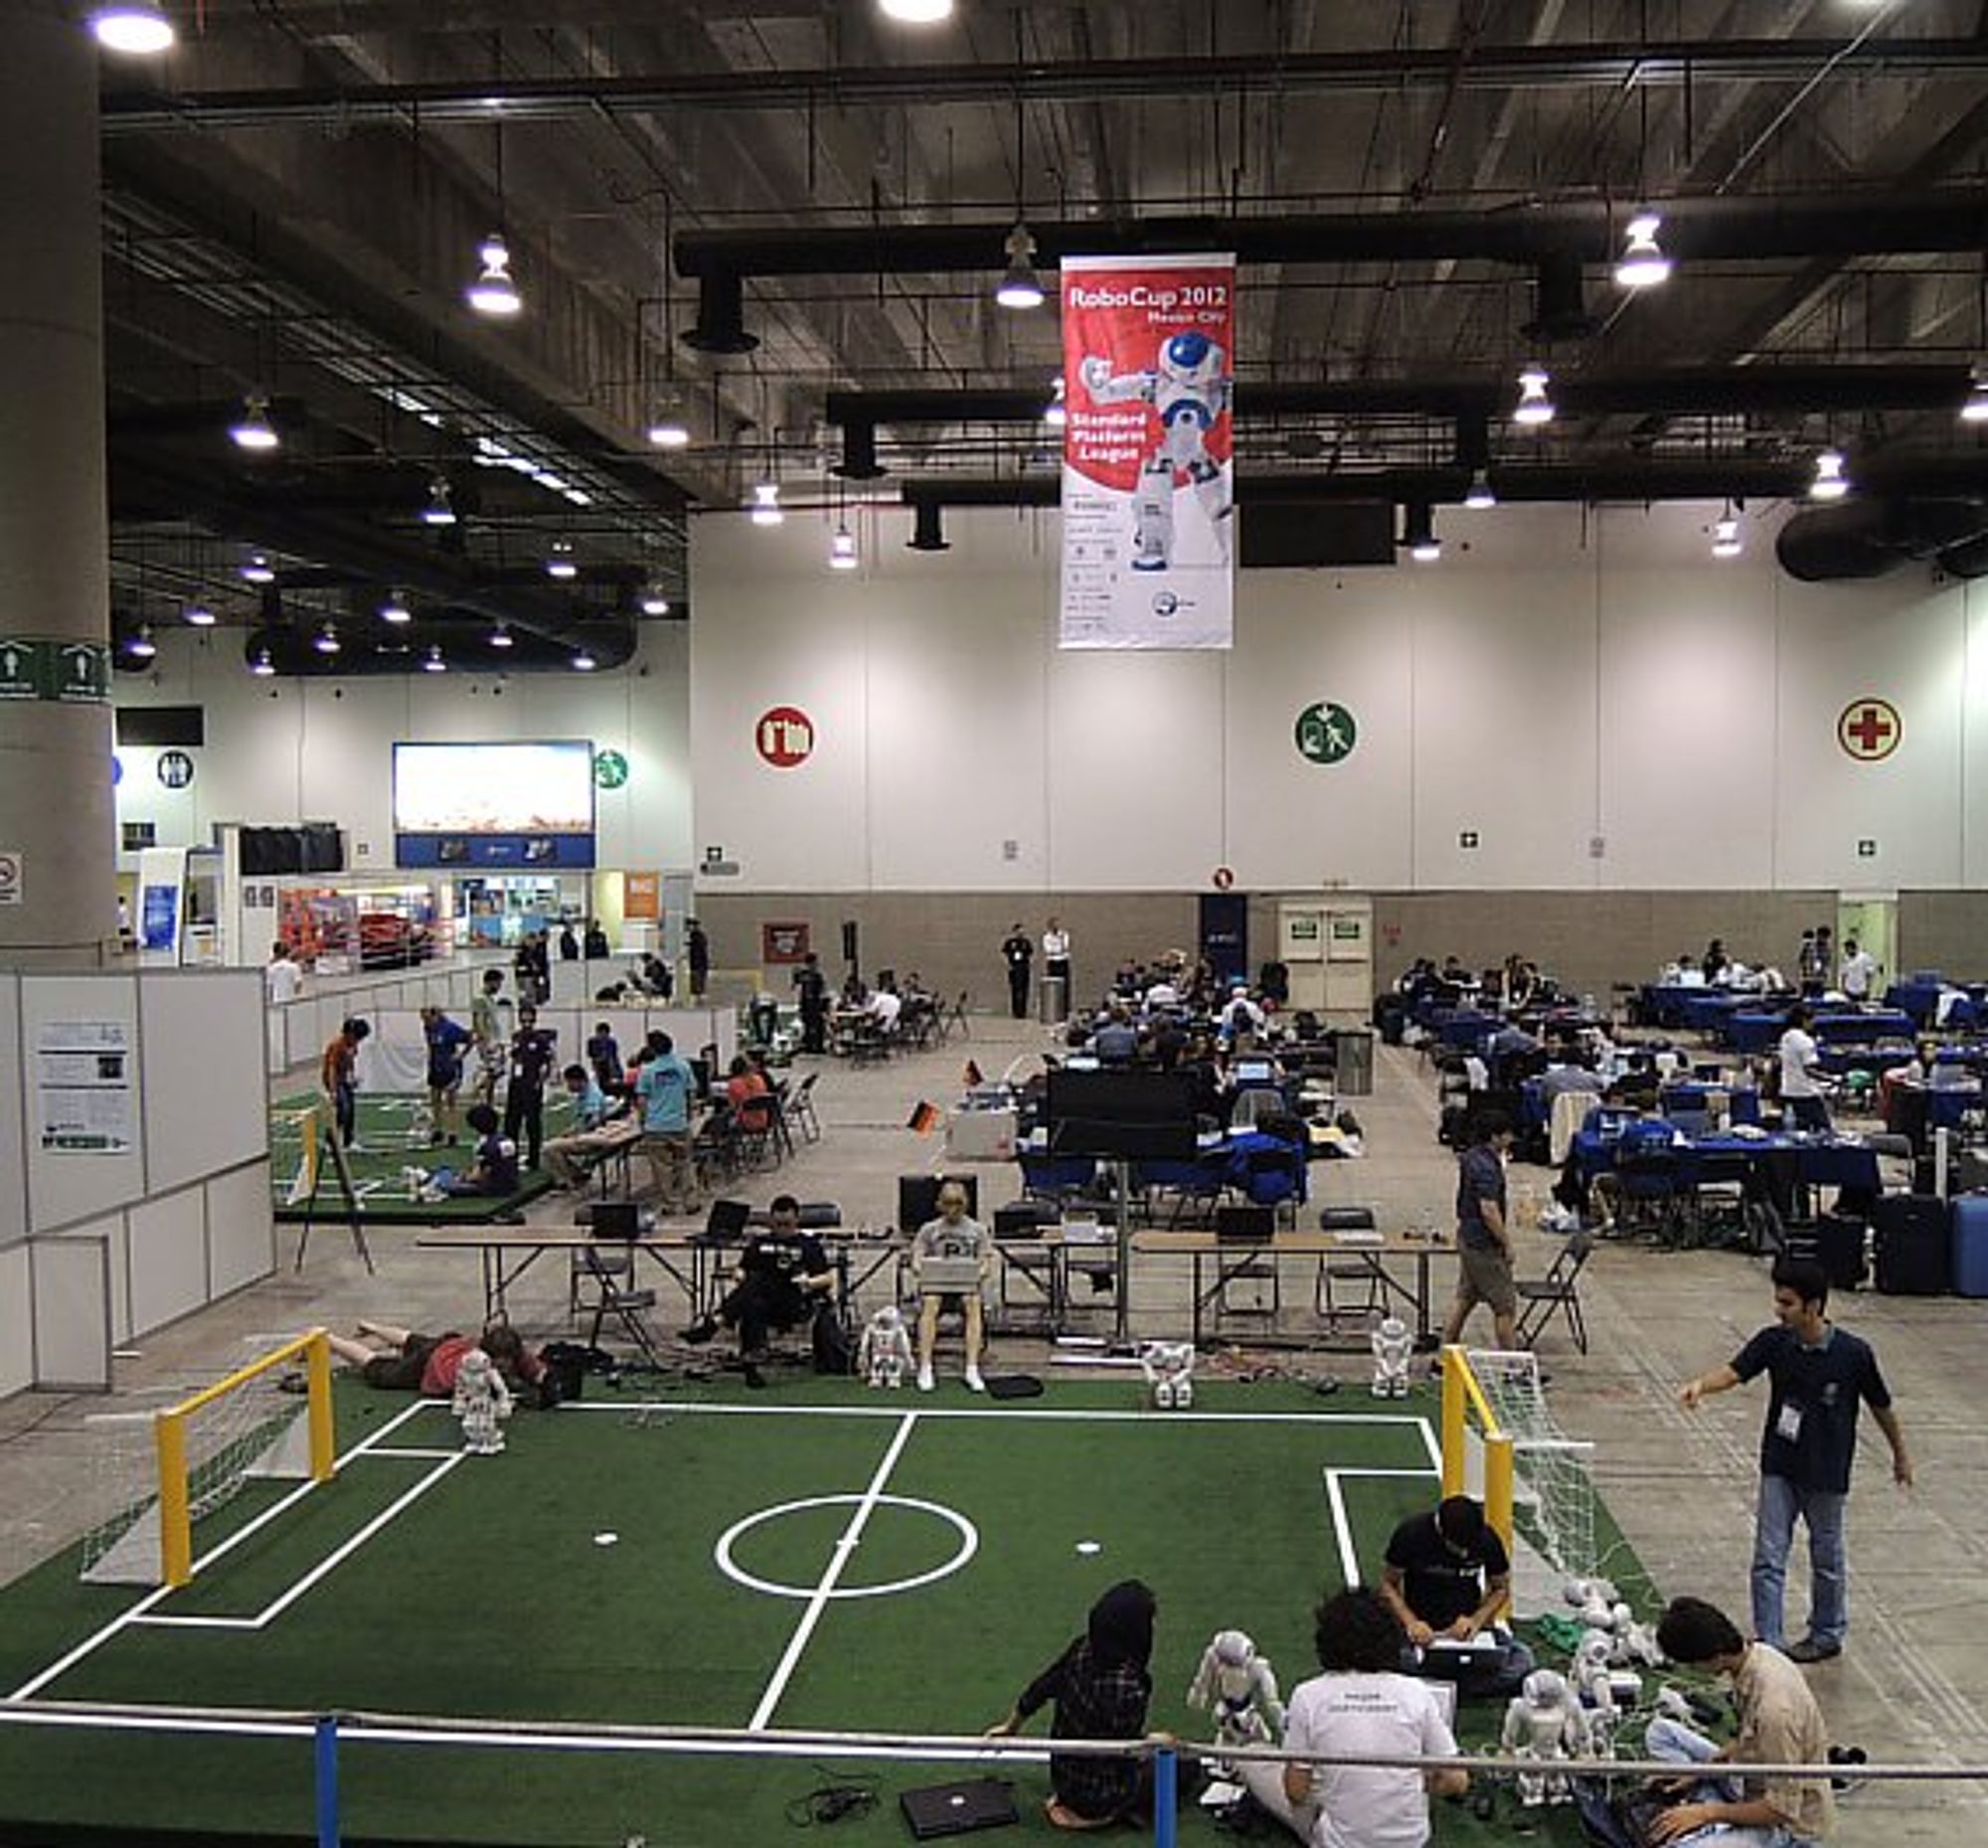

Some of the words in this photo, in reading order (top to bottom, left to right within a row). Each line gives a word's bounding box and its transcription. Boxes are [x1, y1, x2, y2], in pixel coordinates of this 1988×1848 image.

[1071, 287, 1177, 311] RoboCup
[1180, 287, 1226, 305] 2012
[1080, 445, 1139, 463] League
